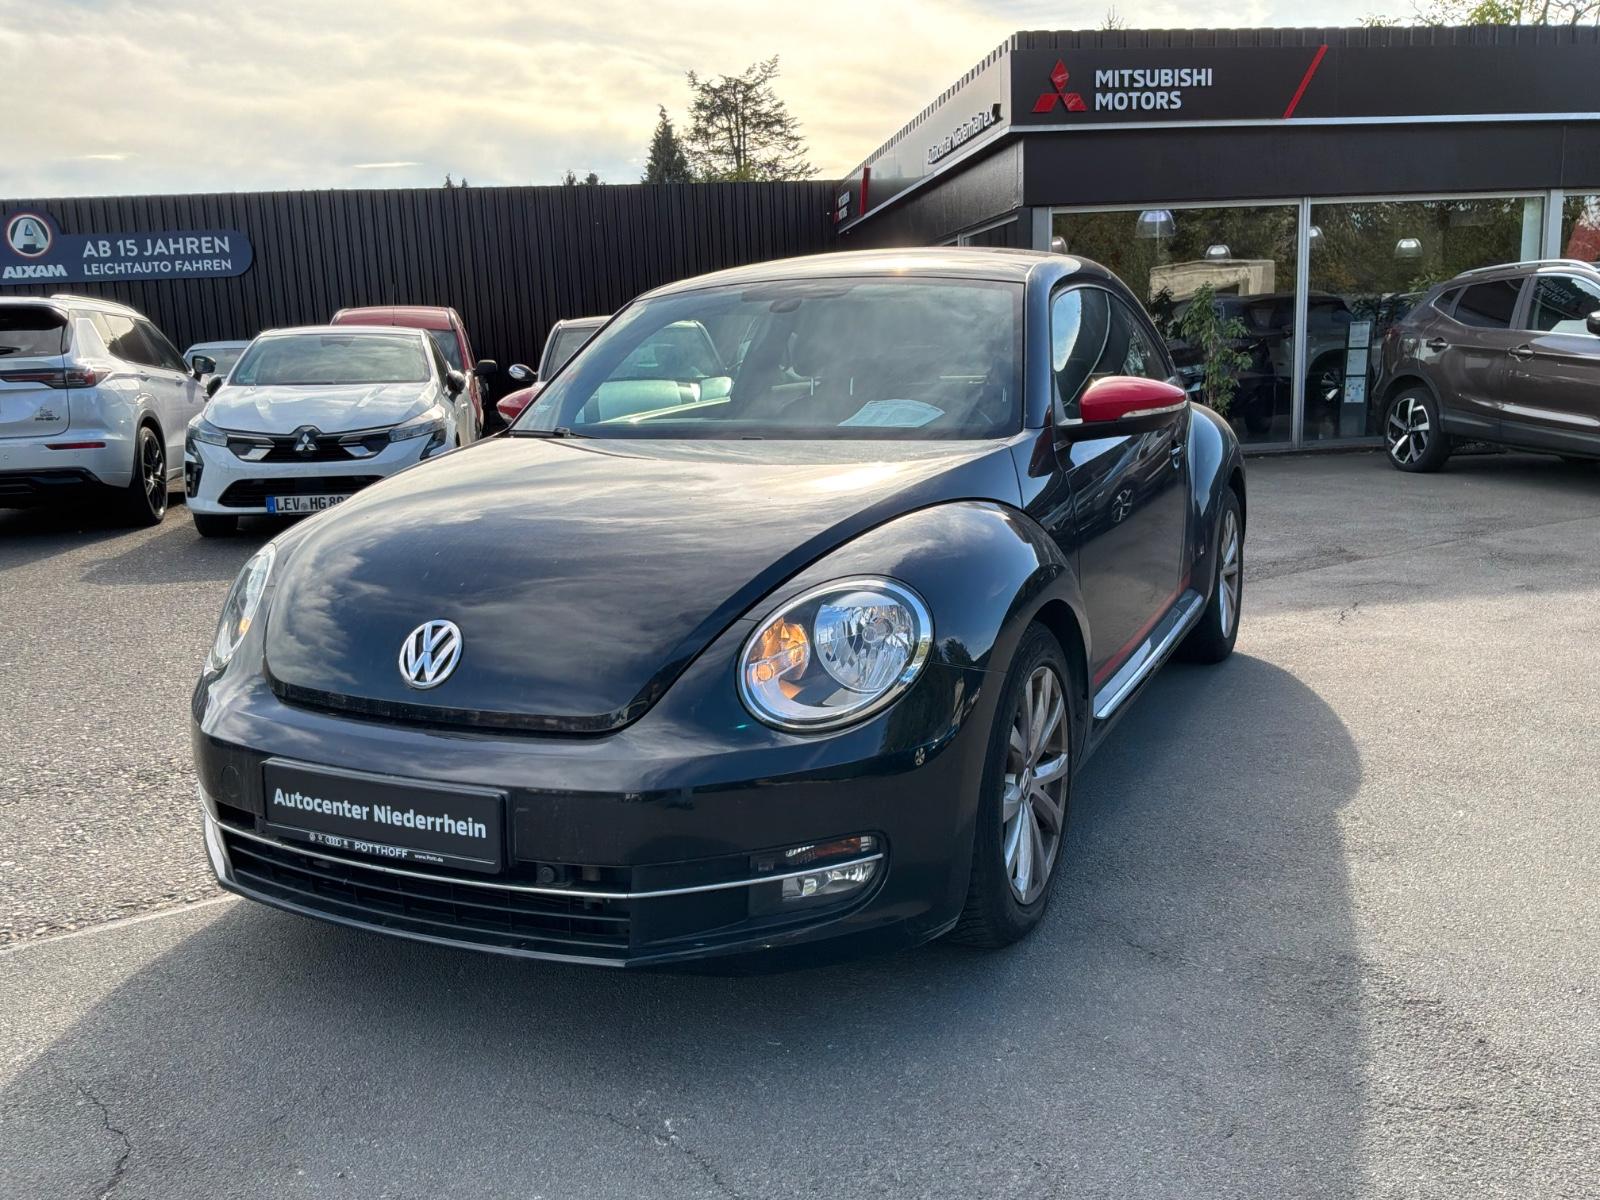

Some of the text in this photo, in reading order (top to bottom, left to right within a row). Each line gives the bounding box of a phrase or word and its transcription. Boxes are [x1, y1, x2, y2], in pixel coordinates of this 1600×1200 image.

[1095, 68, 1213, 88] MITSUBISHI
[1095, 91, 1182, 110] MOTORS
[83, 236, 230, 258] AB 15 JAHREN
[2, 264, 68, 279] AIXAM
[83, 259, 232, 275] LEICHTAUTO FAHREN
[275, 498, 300, 511] LEV
[310, 497, 327, 510] HG
[274, 788, 487, 839] Autocenter Niederrhein
[354, 840, 408, 859] POTTHOFF
